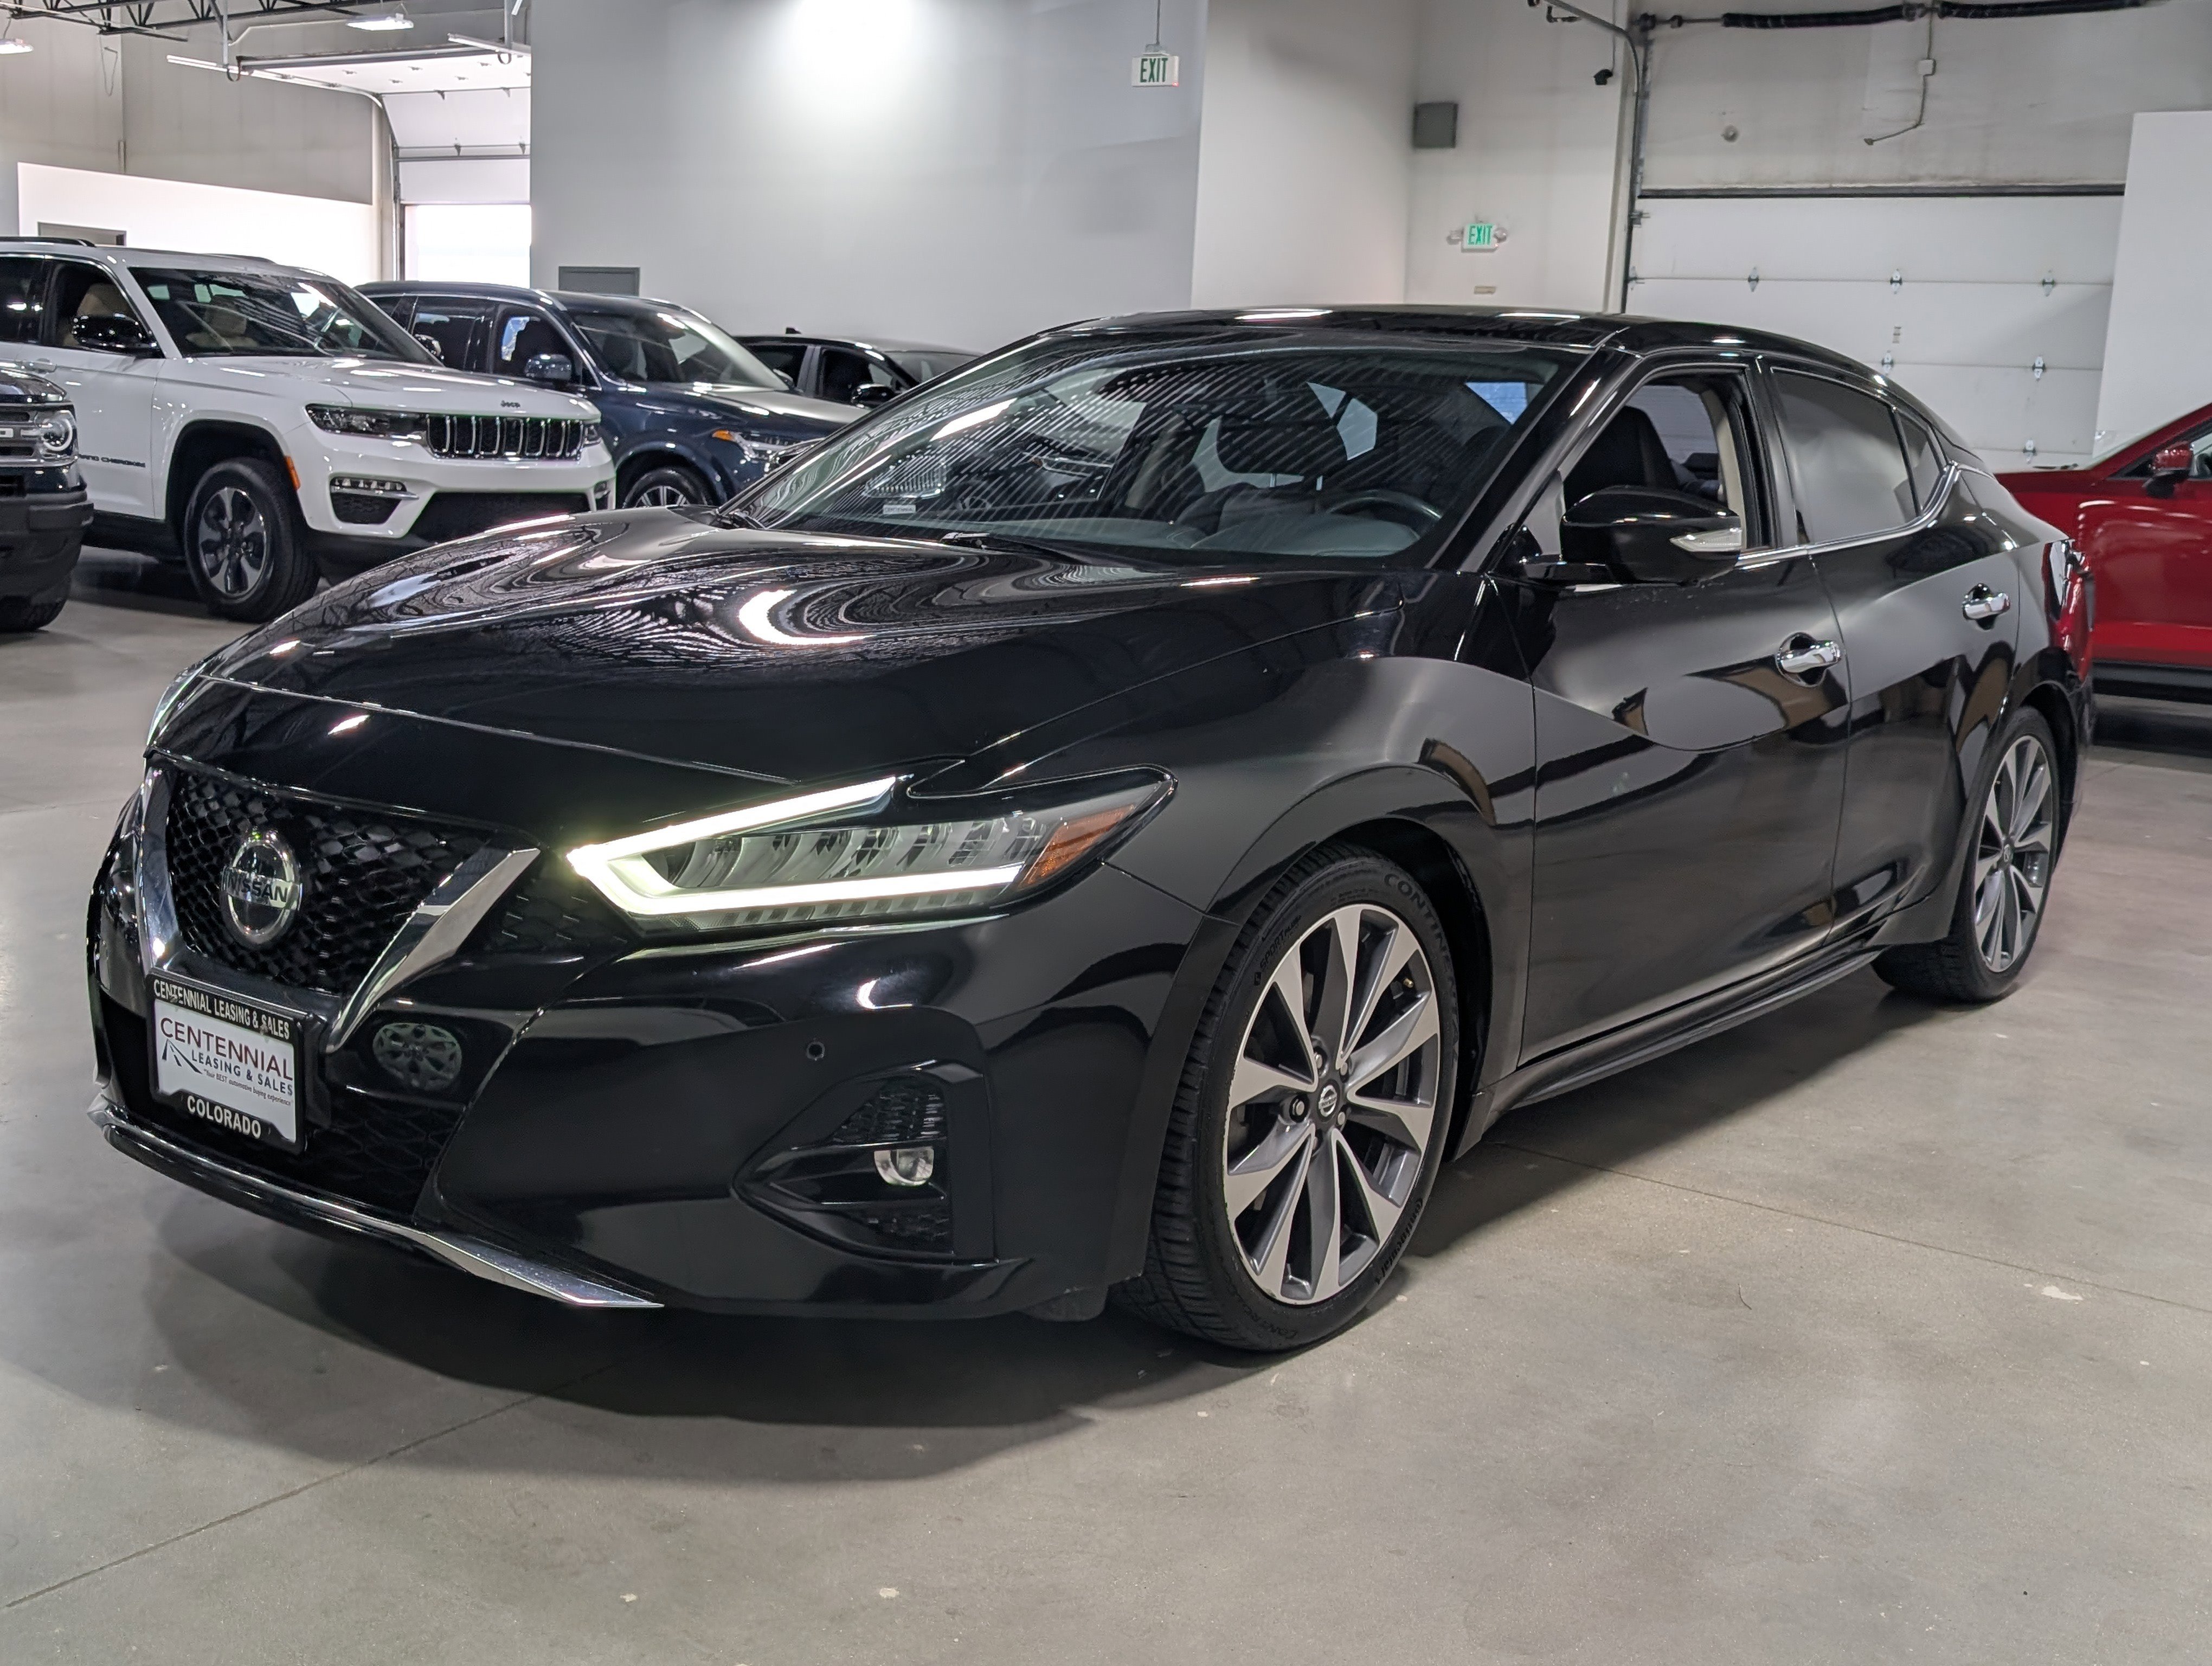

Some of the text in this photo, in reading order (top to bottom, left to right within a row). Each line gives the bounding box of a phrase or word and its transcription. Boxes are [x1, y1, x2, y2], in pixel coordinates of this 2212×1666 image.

[1140, 57, 1168, 82] EXIT
[1468, 225, 1493, 245] EXIT
[153, 979, 290, 1040] CENTENNIAL LEASING & SALES
[160, 1017, 293, 1081] CENTENNIAL
[191, 1049, 293, 1097] LEASING & SALES
[216, 1073, 227, 1084] BEST
[253, 1086, 266, 1099] buying
[187, 1095, 261, 1139] COLORADO
